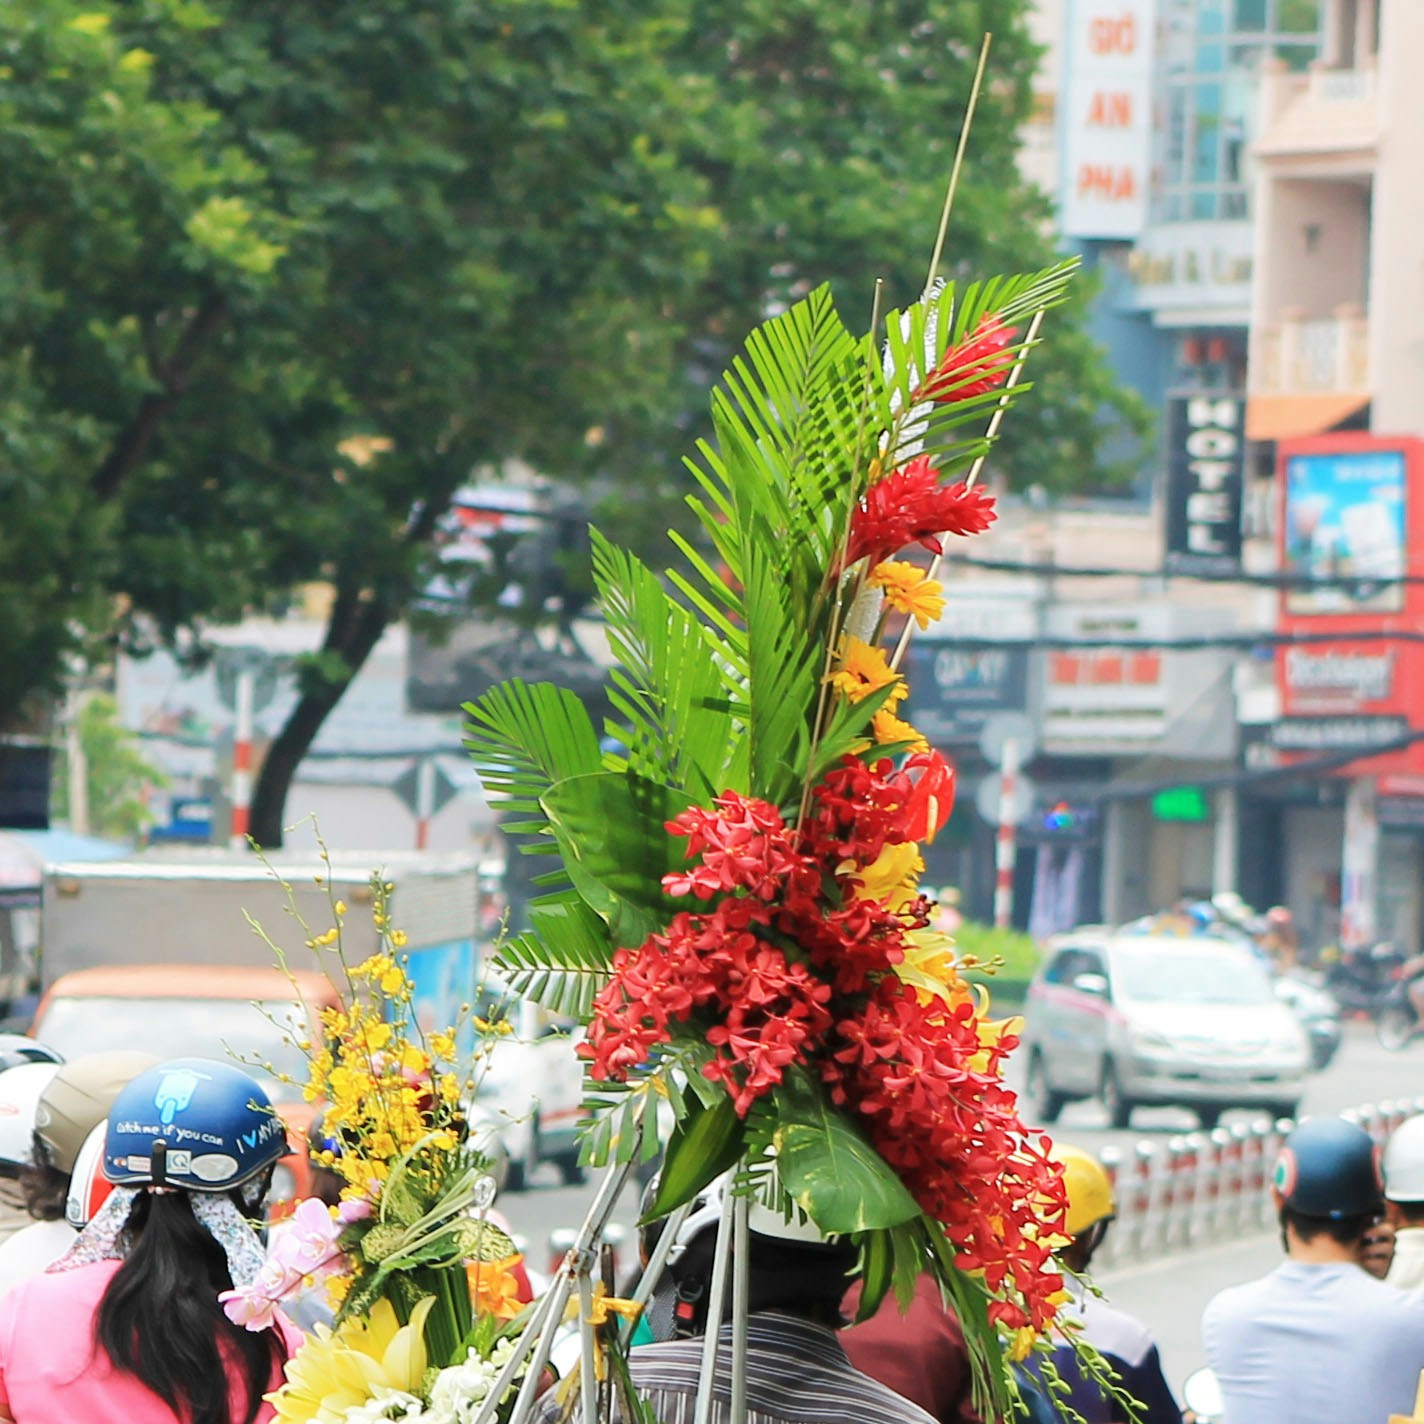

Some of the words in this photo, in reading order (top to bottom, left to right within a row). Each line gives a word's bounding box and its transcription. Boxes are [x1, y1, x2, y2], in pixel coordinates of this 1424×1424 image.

[1186, 398, 1237, 553] HOTEL
[143, 1125, 160, 1135] me
[162, 1124, 175, 1136] if
[176, 1127, 201, 1143] you
[201, 1133, 224, 1146] can
